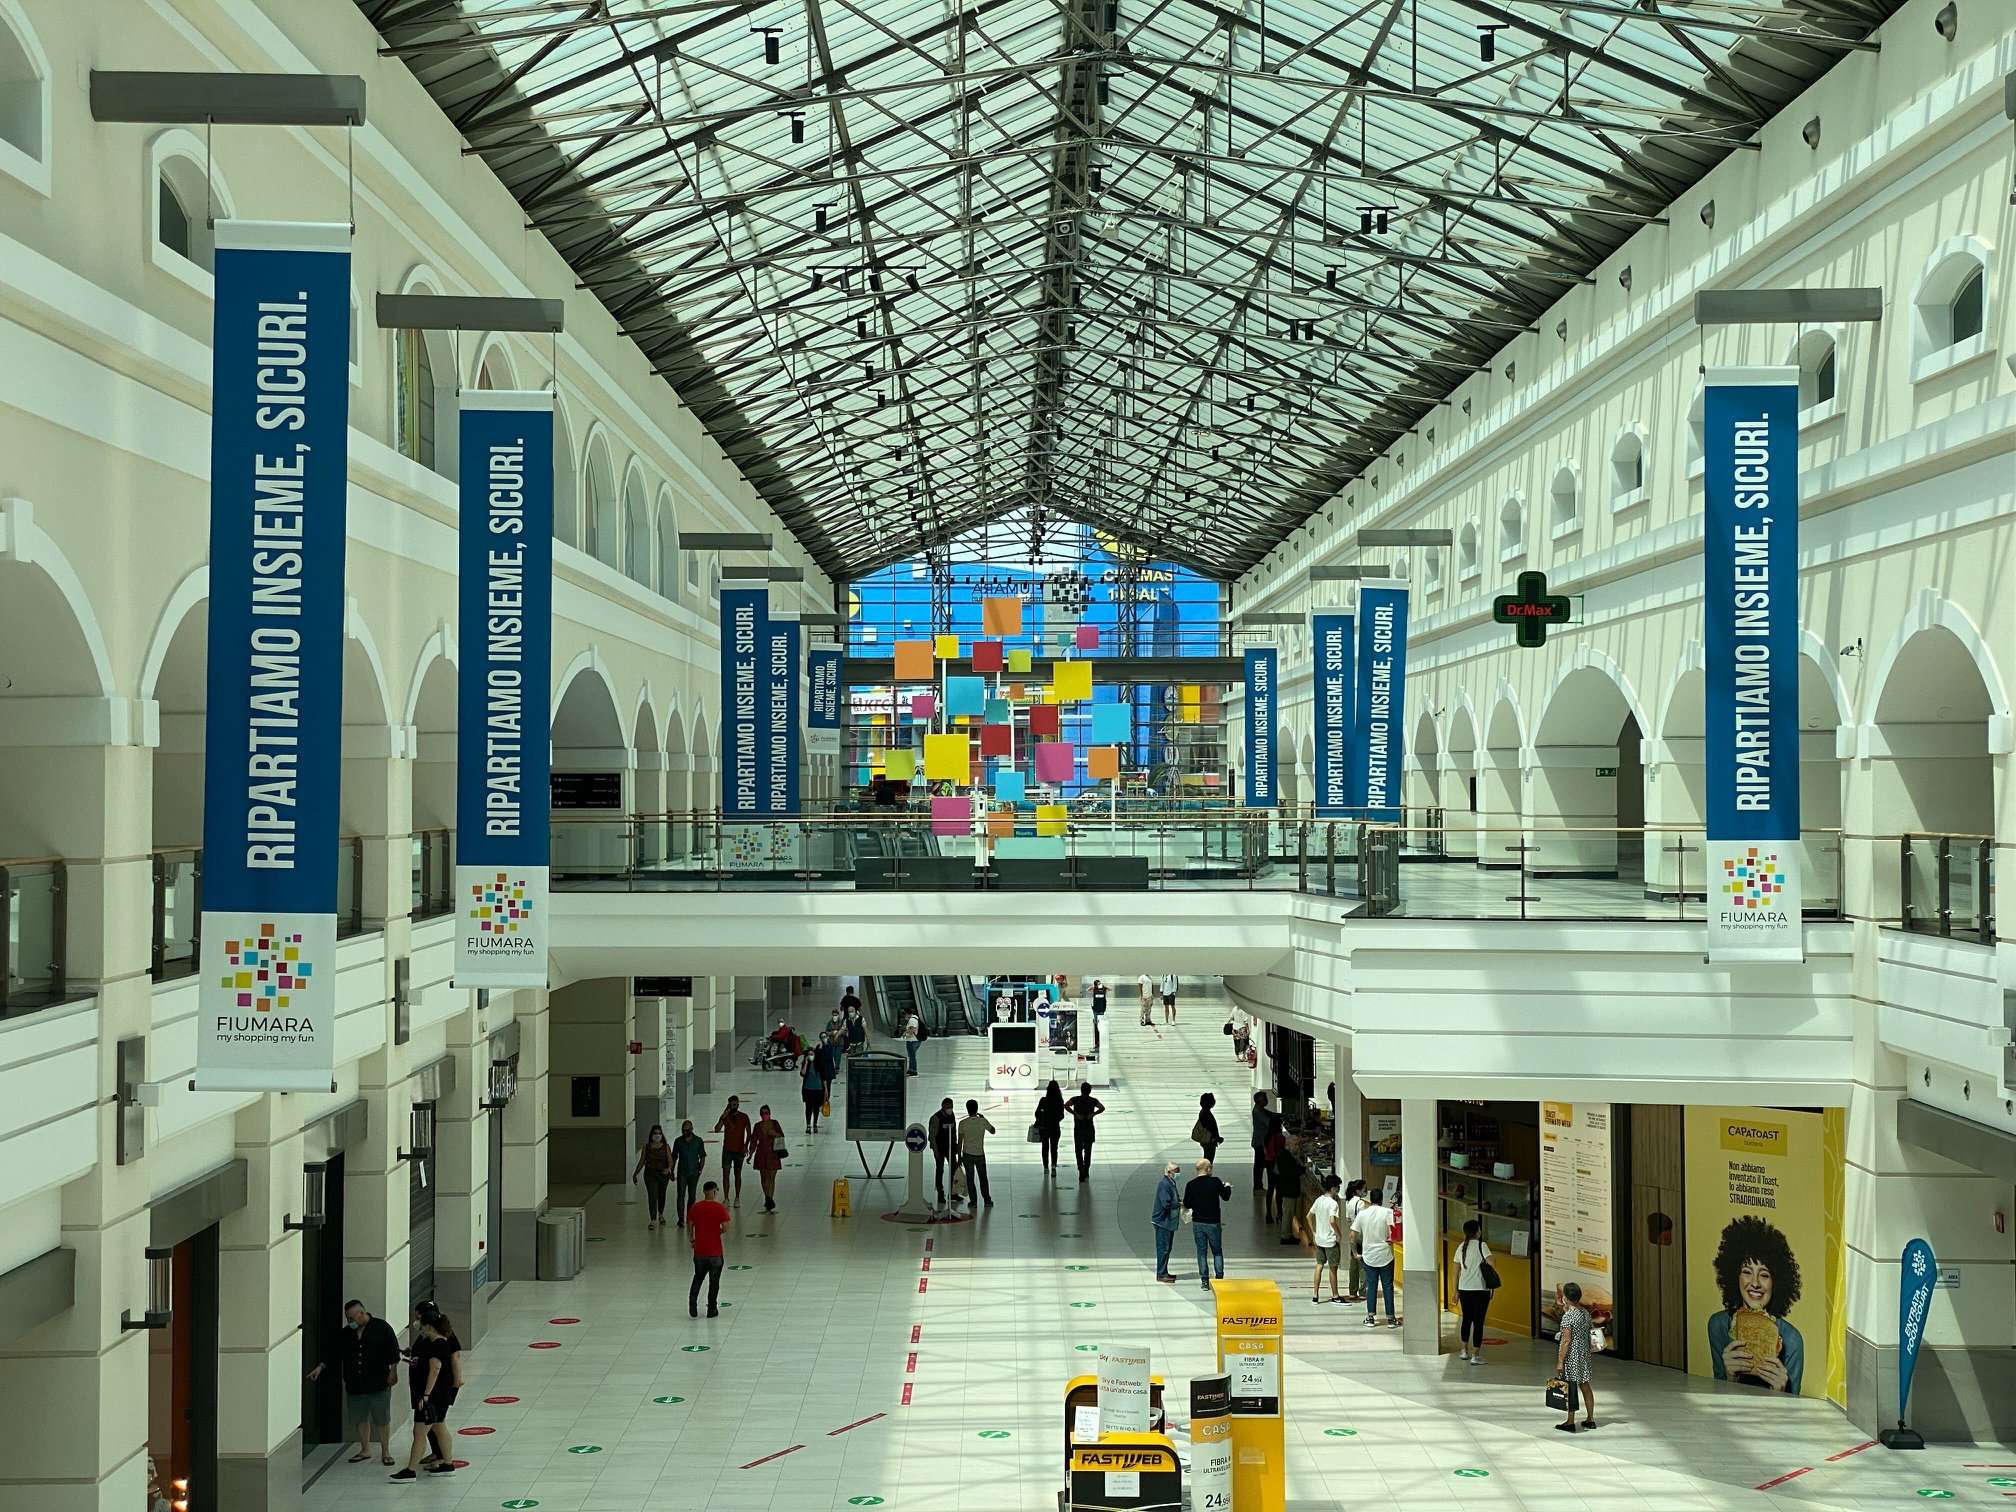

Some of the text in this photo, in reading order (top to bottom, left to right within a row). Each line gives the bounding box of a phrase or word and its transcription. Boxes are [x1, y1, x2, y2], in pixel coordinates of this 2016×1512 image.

[247, 291, 311, 869] RIPARTIAMO INSIEME, SICURI.
[1506, 603, 1553, 617] Dr.Max
[1734, 412, 1774, 811] RIPARTIAMO INSIEME, SICURI.
[486, 438, 528, 836] RIPARTIAMO INSIEME, SICURI.
[814, 665, 825, 712] RIPARTIAMO
[735, 603, 756, 810] RIPARTIAMO INSIEME, SICURI.
[1367, 602, 1394, 808] RIPARTIAMO INSIEME, SICURI.
[771, 632, 789, 811] RIPARTIAMO INSIEME, SICURI.
[1326, 627, 1344, 805] RIPARTIAMO INSIEME, SICURI.
[1255, 657, 1269, 798] RIPARTIAMO INSIEME, SICURI.
[1720, 912, 1787, 922] FIUMARA
[1733, 923, 1763, 931] shopping
[467, 937, 534, 949] FIUMARA
[479, 948, 510, 956] shopping
[217, 1017, 314, 1032] FIUMARA
[217, 1033, 314, 1043] my shopping my fun
[996, 1064, 1017, 1078] sky
[1728, 1126, 1780, 1141] CAPATOAST
[1729, 1161, 1766, 1174] Non abbiamo
[1729, 1172, 1757, 1184] inventato
[1735, 1182, 1761, 1195] abbiamo
[1761, 1187, 1774, 1196] reso
[1904, 1290, 1922, 1336] ENTRATA
[1906, 1284, 1930, 1356] FOOD COURT
[1222, 1317, 1278, 1327] FASTWEB
[1081, 1453, 1163, 1469] FASTWEB
